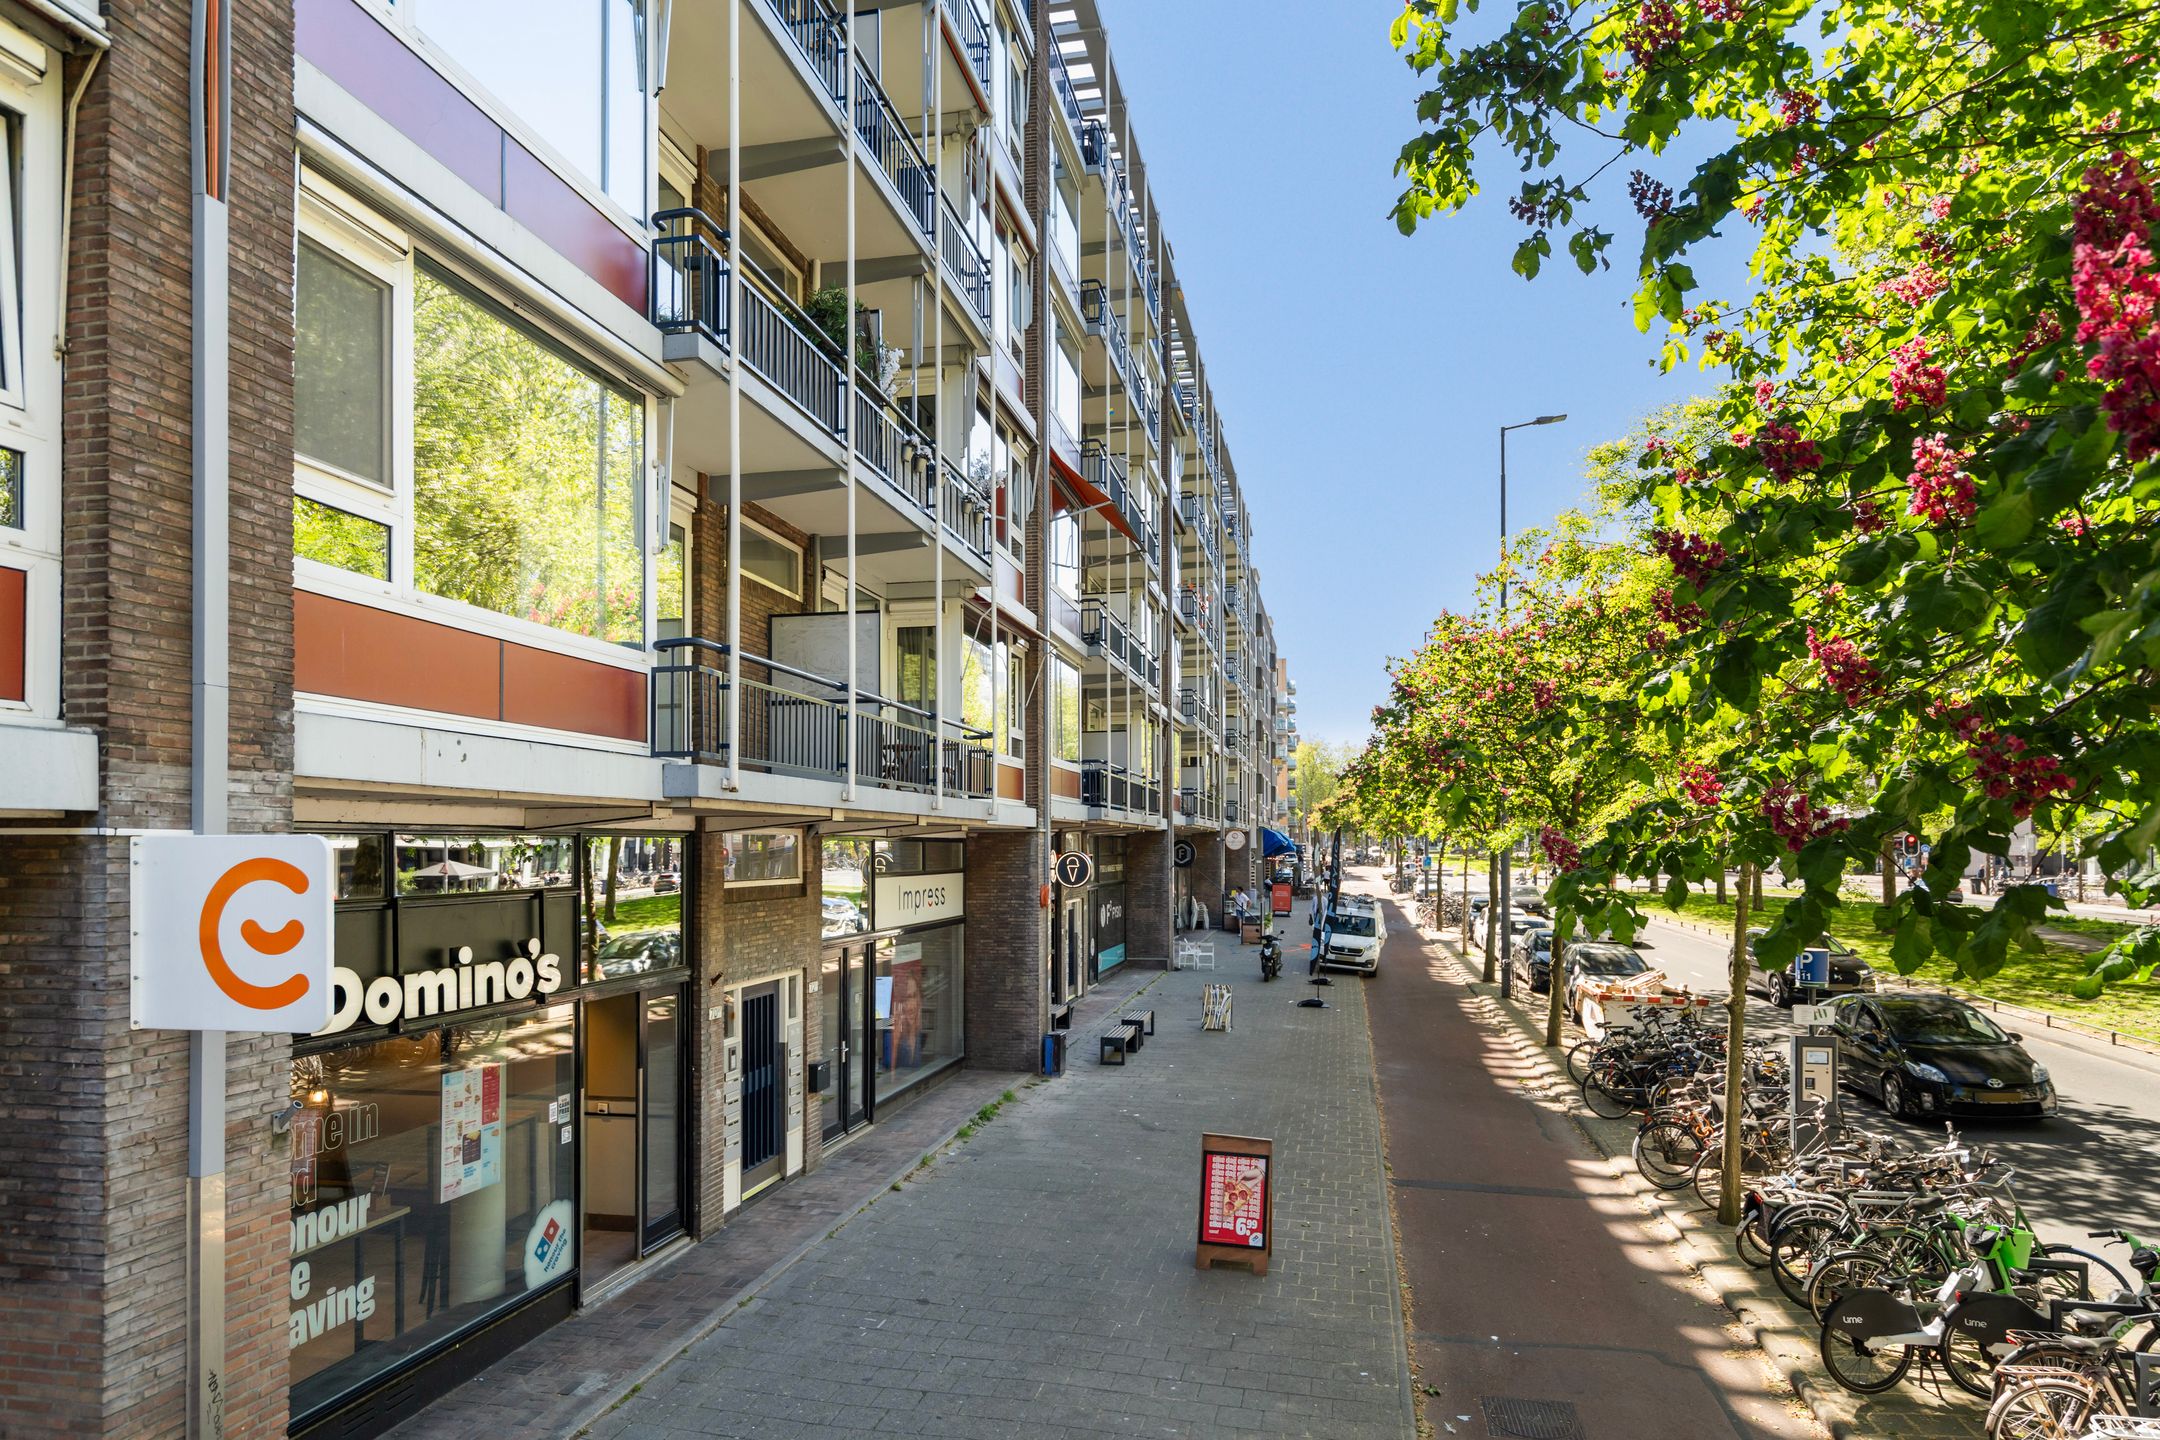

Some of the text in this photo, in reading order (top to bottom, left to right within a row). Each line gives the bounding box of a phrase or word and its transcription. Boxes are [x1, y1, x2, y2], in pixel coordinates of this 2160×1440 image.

[898, 884, 946, 915] Impress
[1801, 952, 1814, 969] P
[311, 938, 562, 1037] Domino's
[349, 1101, 379, 1145] in
[1235, 1217, 1258, 1236] 6.99
